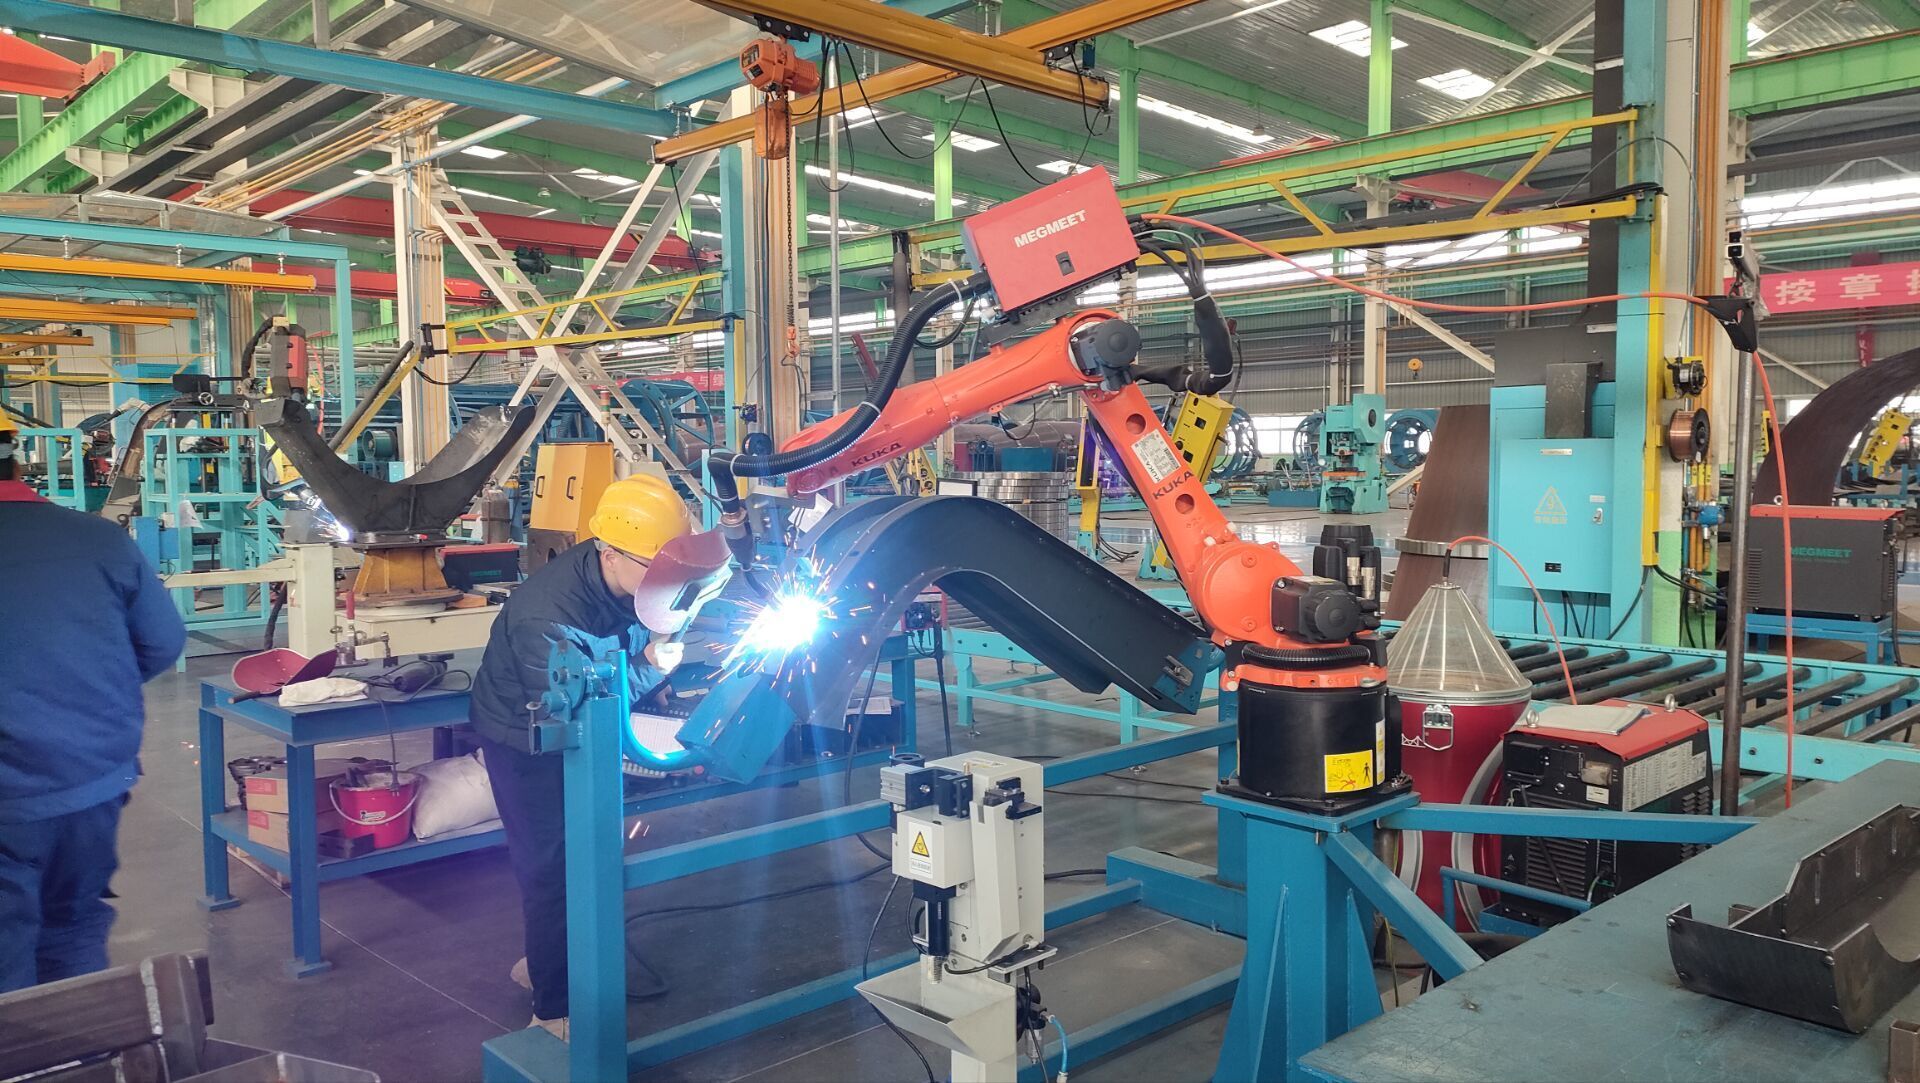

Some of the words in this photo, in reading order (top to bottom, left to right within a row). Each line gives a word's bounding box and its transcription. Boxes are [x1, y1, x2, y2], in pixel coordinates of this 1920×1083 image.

[1014, 209, 1087, 248] MEGMEET
[851, 442, 903, 467] KUKA
[1152, 470, 1195, 500] KUKA
